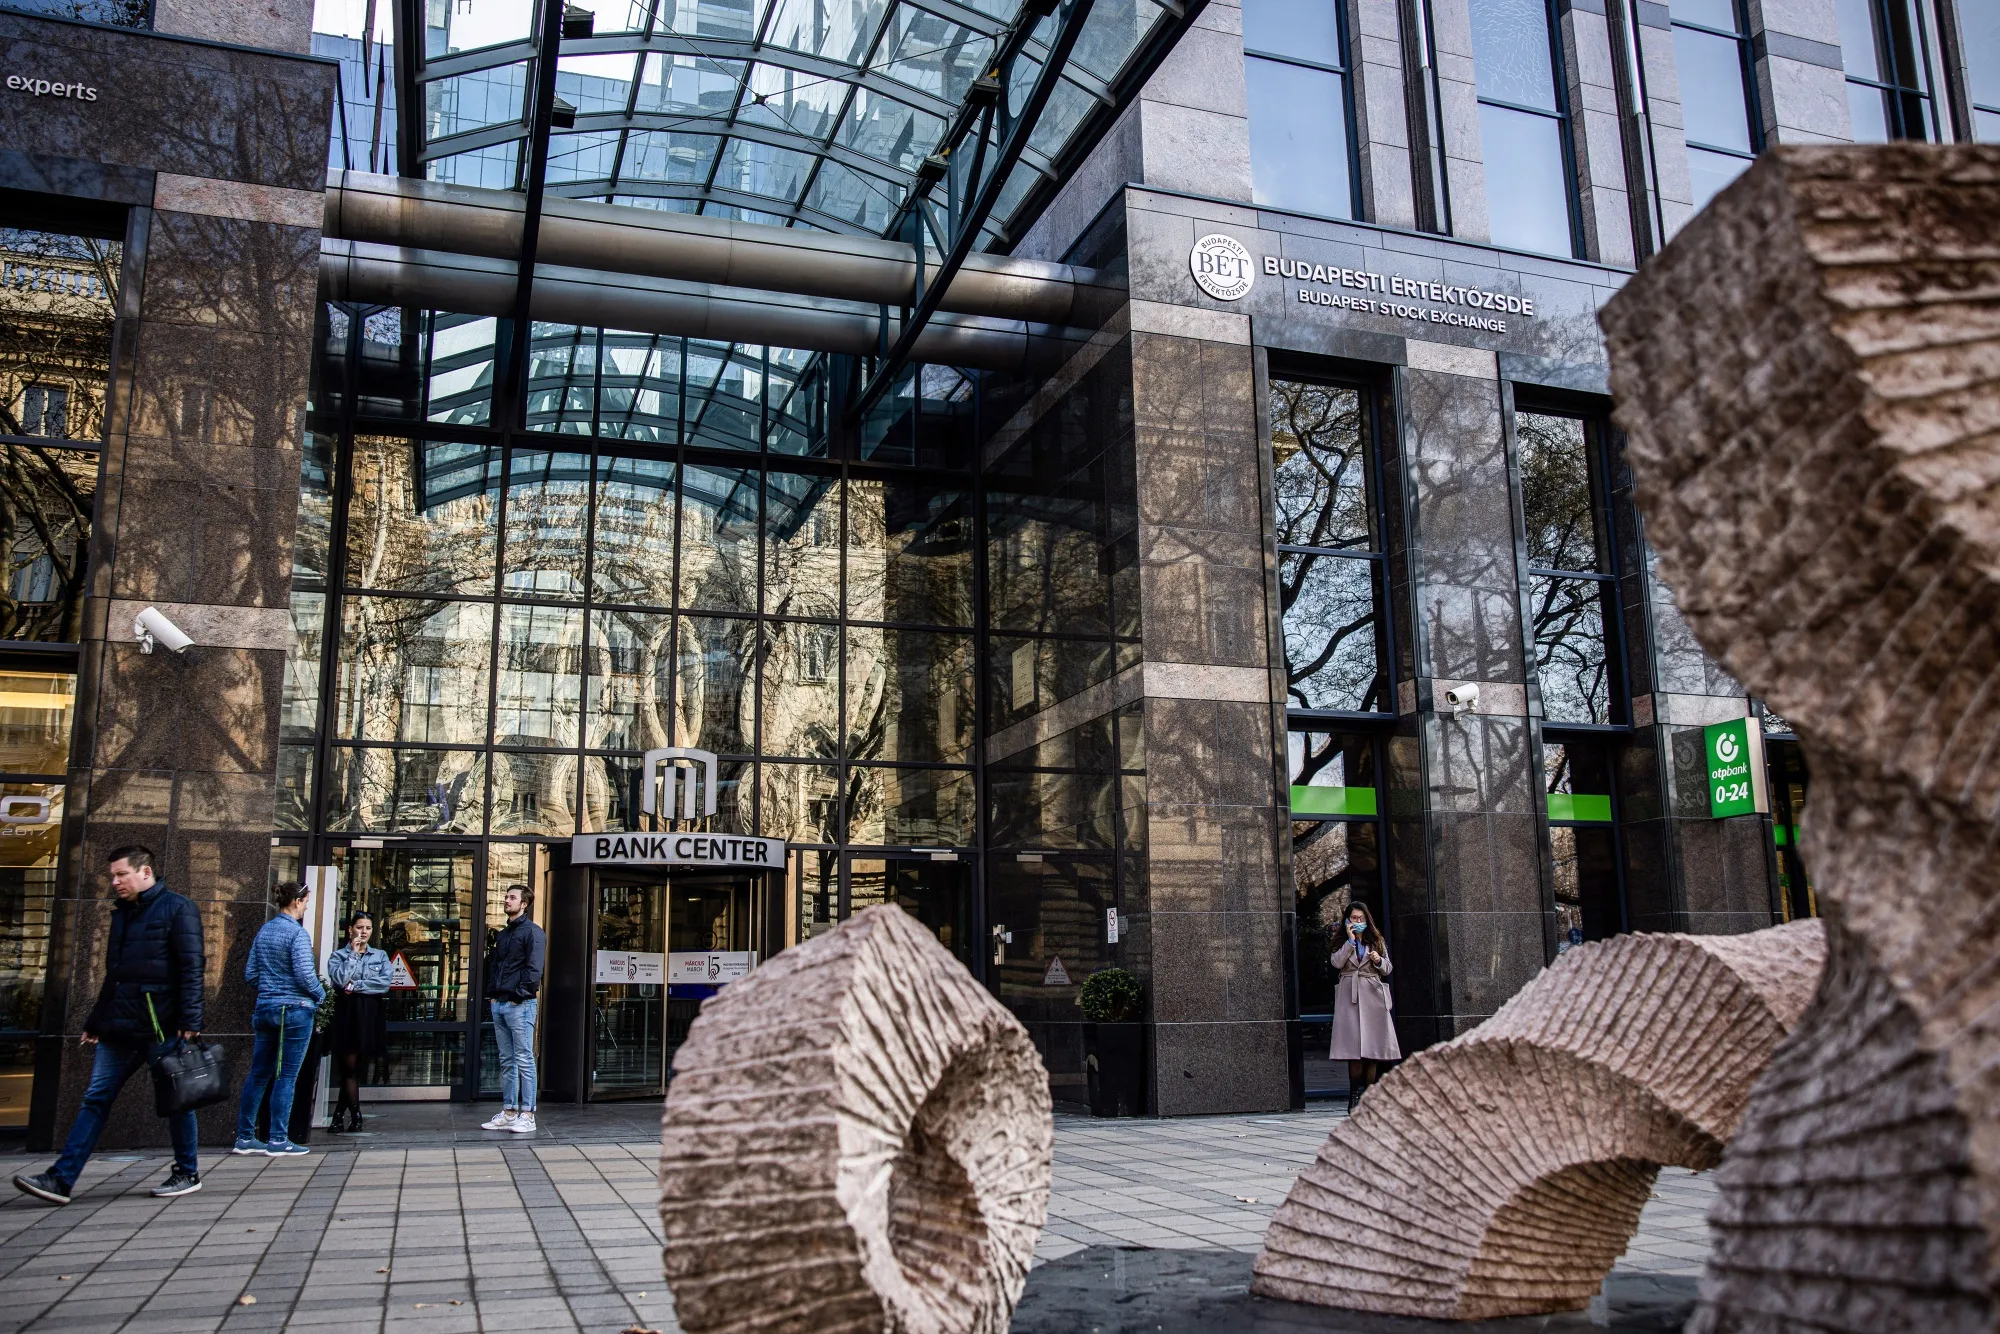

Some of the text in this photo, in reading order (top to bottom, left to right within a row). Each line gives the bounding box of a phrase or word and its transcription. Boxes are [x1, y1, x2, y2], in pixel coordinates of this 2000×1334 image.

[6, 75, 98, 101] experts
[1201, 237, 1244, 255] BUDAPESTI
[1197, 249, 1249, 280] BÉT
[1263, 256, 1534, 317] BUDAPESTI ÉRTÉKTŐZSDE
[1298, 289, 1507, 334] BUDAPEST STOCK EXCHANGE
[1711, 762, 1748, 781] otpbank
[1715, 782, 1749, 804] 0-24
[2, 828, 47, 836] 2017
[595, 837, 769, 863] BANK CENTER
[628, 955, 637, 977] 15
[708, 955, 720, 977] 15
